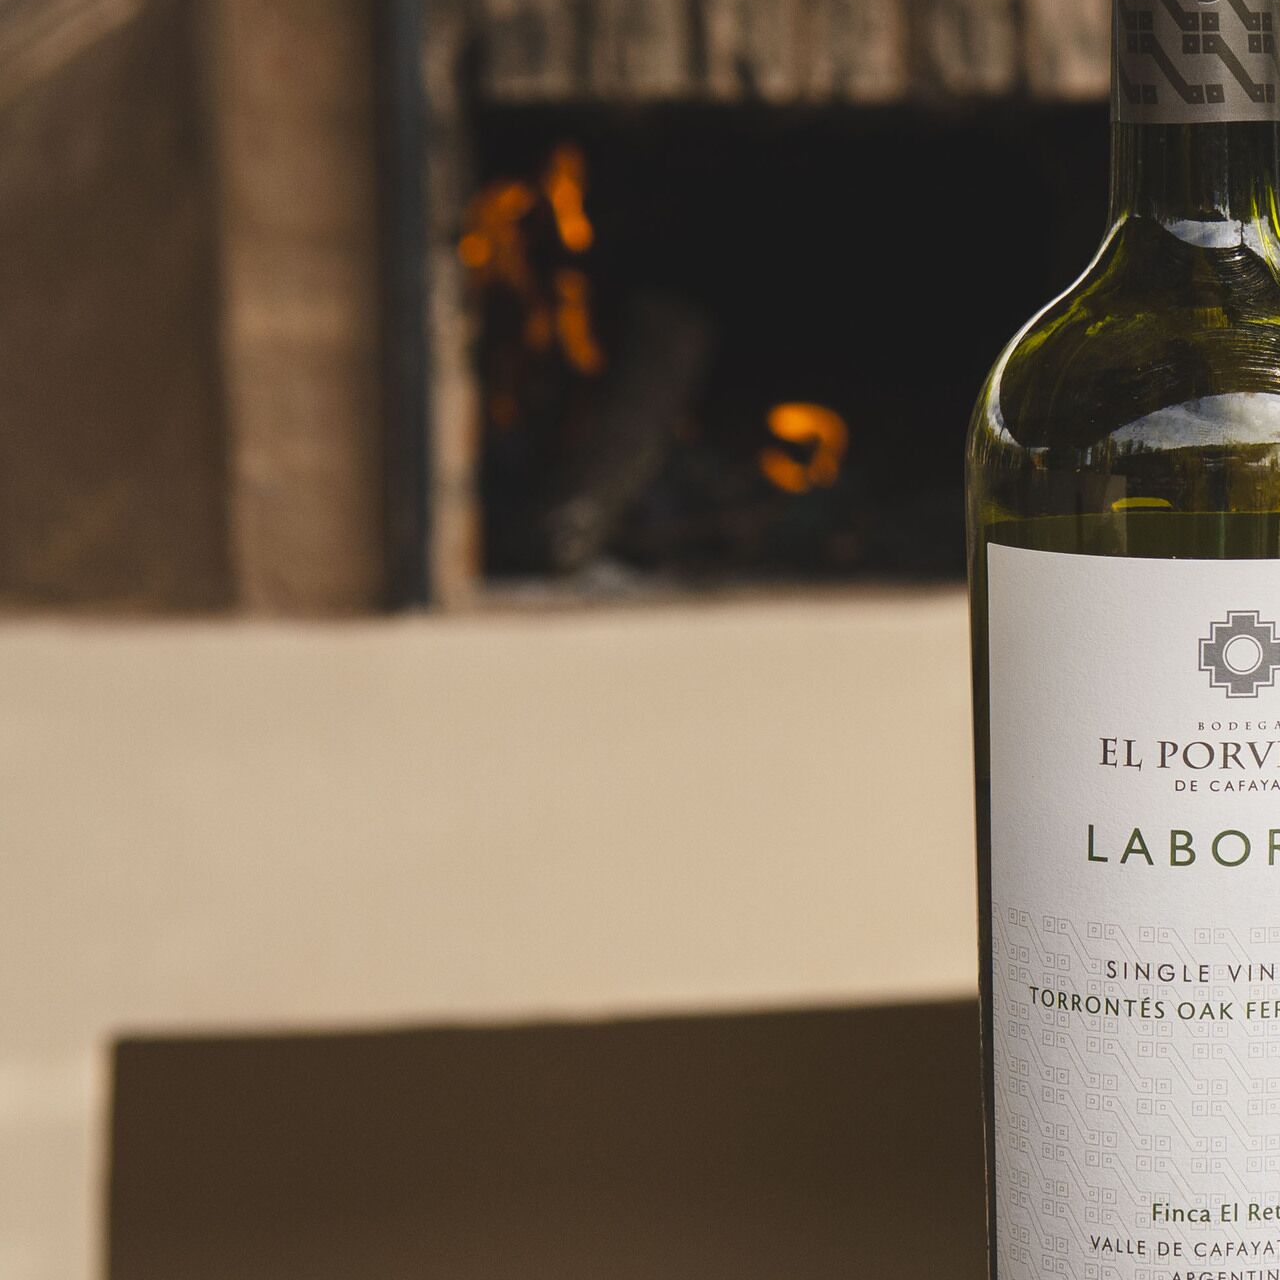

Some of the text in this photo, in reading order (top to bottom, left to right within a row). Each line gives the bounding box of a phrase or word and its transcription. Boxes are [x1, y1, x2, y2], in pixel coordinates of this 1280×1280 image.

[1099, 737, 1143, 771] EL
[1175, 779, 1198, 792] DE
[1106, 960, 1210, 983] SINGLE
[1029, 986, 1166, 1020] TORRONTÉS
[1177, 1001, 1235, 1020] OAK
[1152, 1203, 1212, 1223] Finca
[1220, 1203, 1239, 1222] El
[1089, 1234, 1147, 1255] VALLE
[1157, 1241, 1182, 1258] DE
